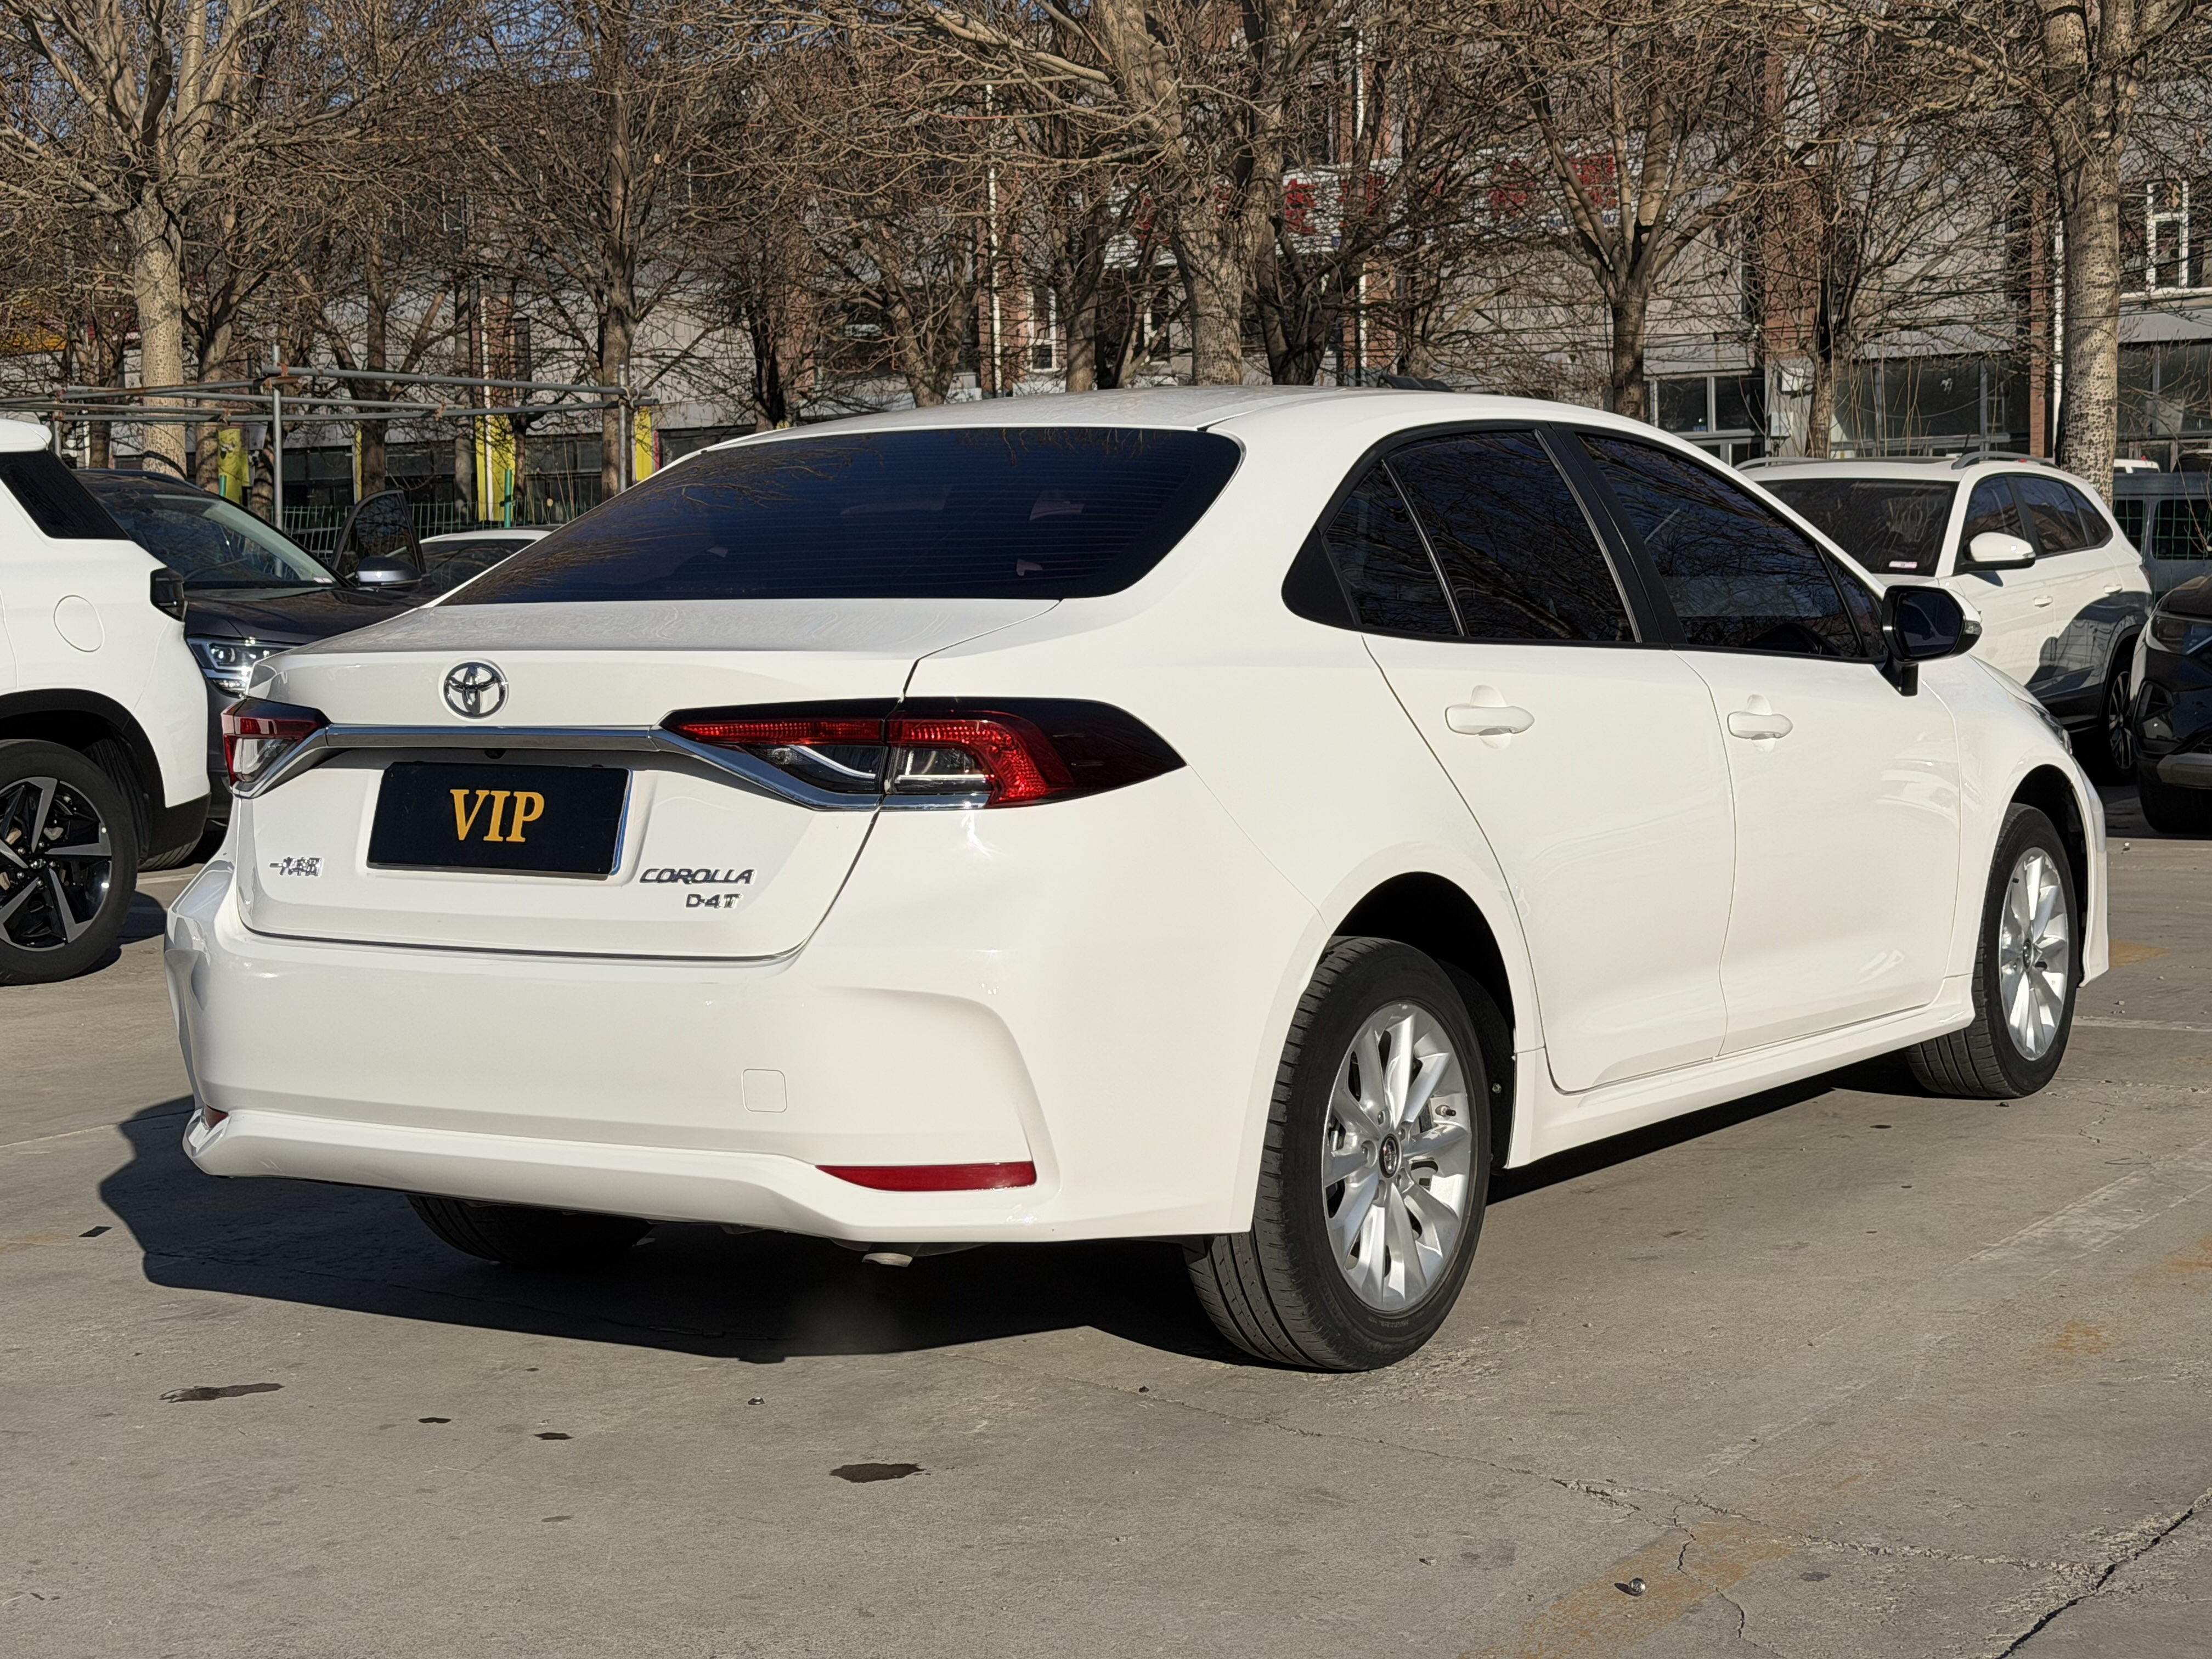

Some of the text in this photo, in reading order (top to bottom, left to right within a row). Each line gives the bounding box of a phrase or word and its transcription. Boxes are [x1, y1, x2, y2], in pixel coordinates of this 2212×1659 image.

[450, 789, 545, 842] VIP
[639, 868, 756, 884] COROLLA
[686, 893, 743, 909] D-4T
